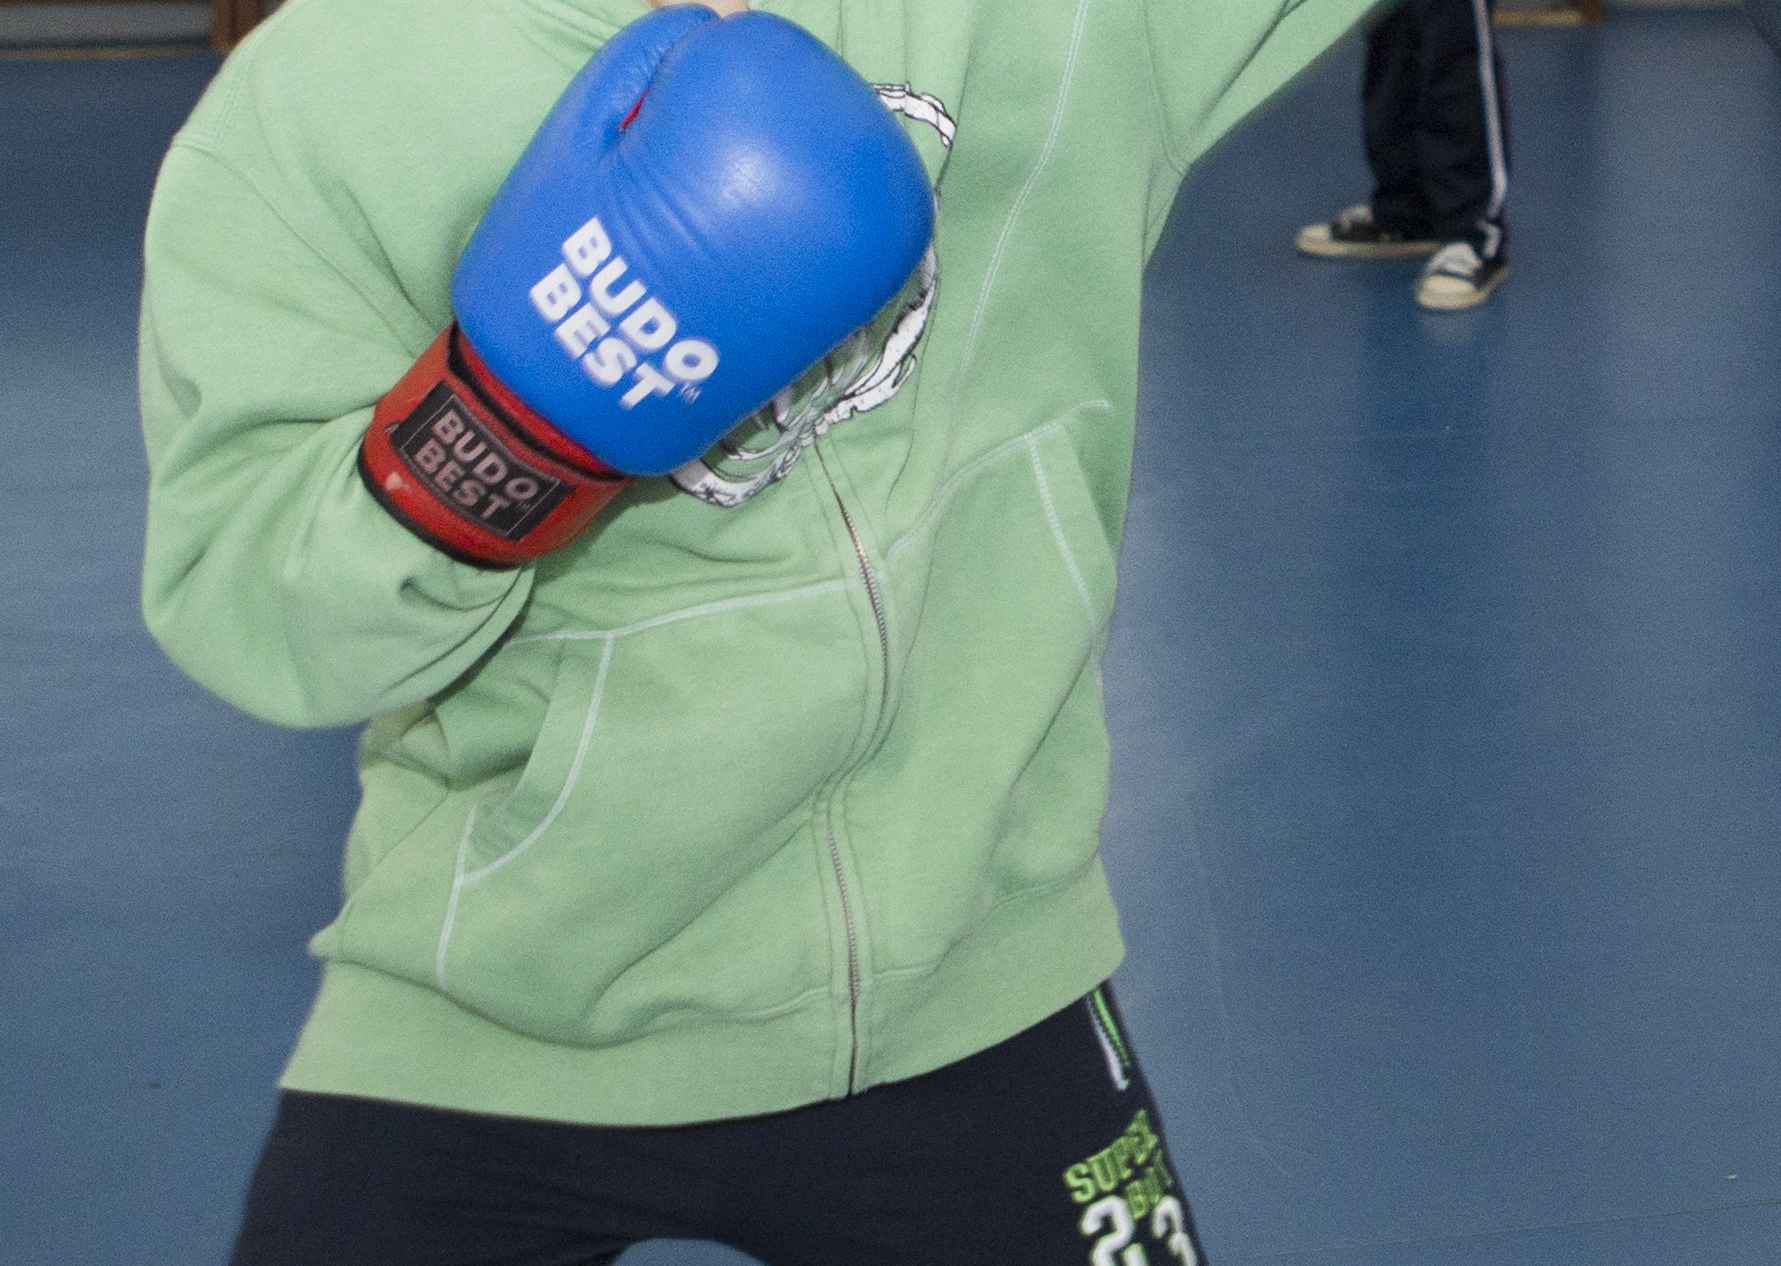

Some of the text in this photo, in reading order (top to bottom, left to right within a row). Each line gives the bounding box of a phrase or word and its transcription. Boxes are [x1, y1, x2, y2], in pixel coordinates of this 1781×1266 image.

[529, 262, 676, 411] BEST
[561, 215, 720, 382] BUDO
[413, 437, 513, 520] BEST
[431, 408, 540, 501] BUDO
